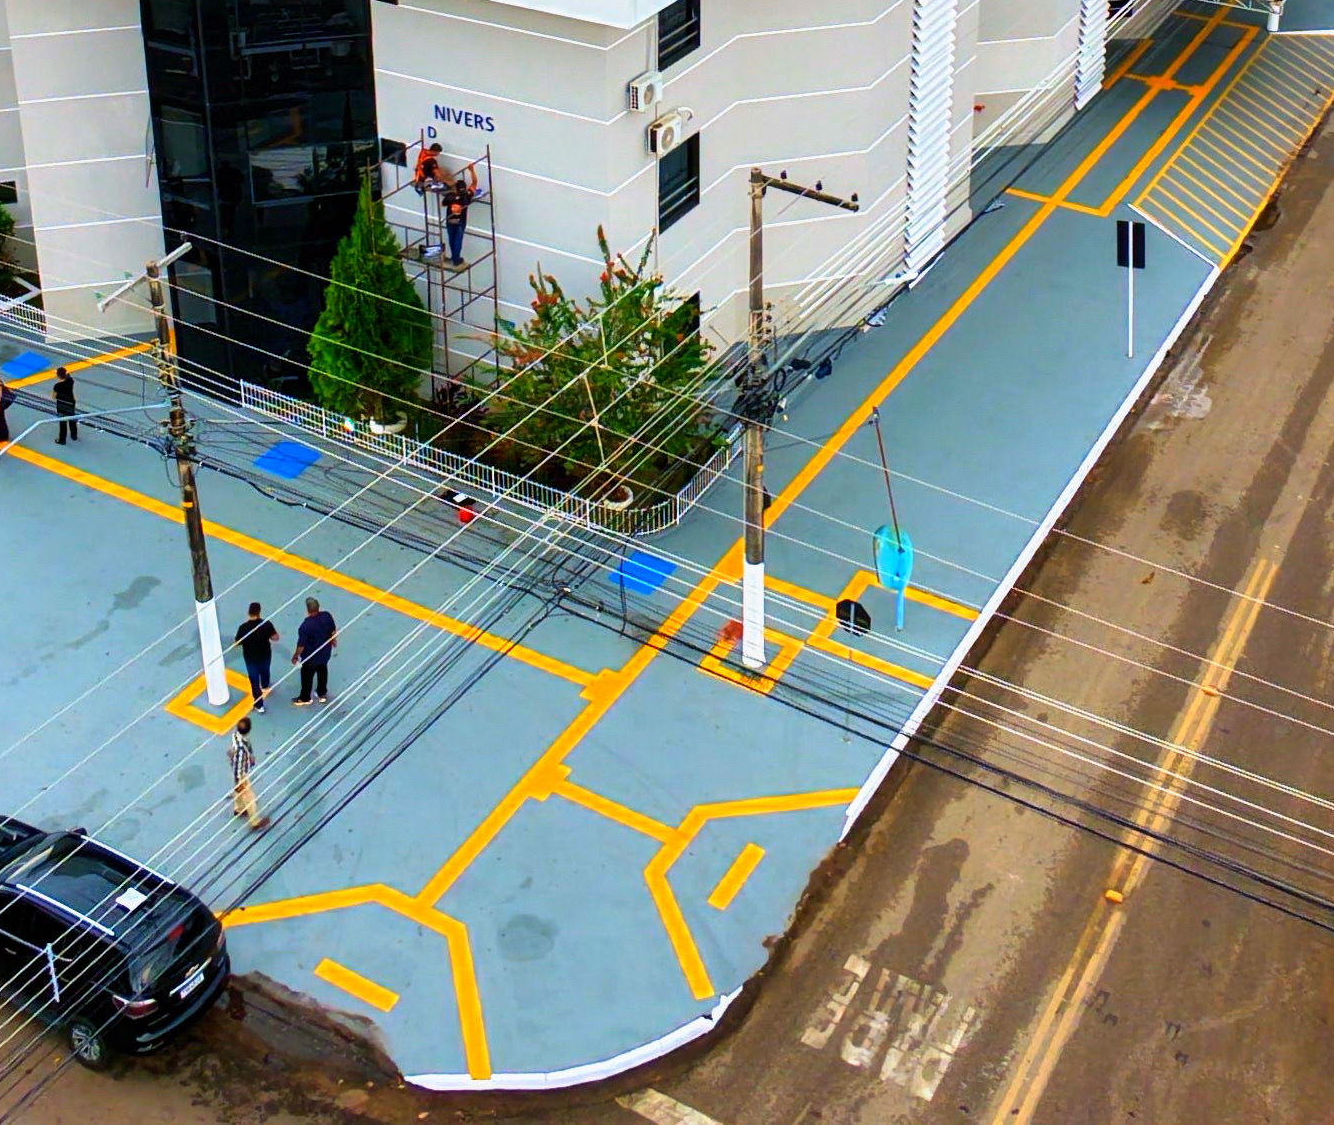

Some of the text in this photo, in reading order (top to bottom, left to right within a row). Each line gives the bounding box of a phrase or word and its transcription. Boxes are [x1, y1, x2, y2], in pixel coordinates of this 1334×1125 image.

[434, 104, 495, 132] NIVERS
[427, 126, 437, 139] D
[800, 953, 976, 1102] PARE
